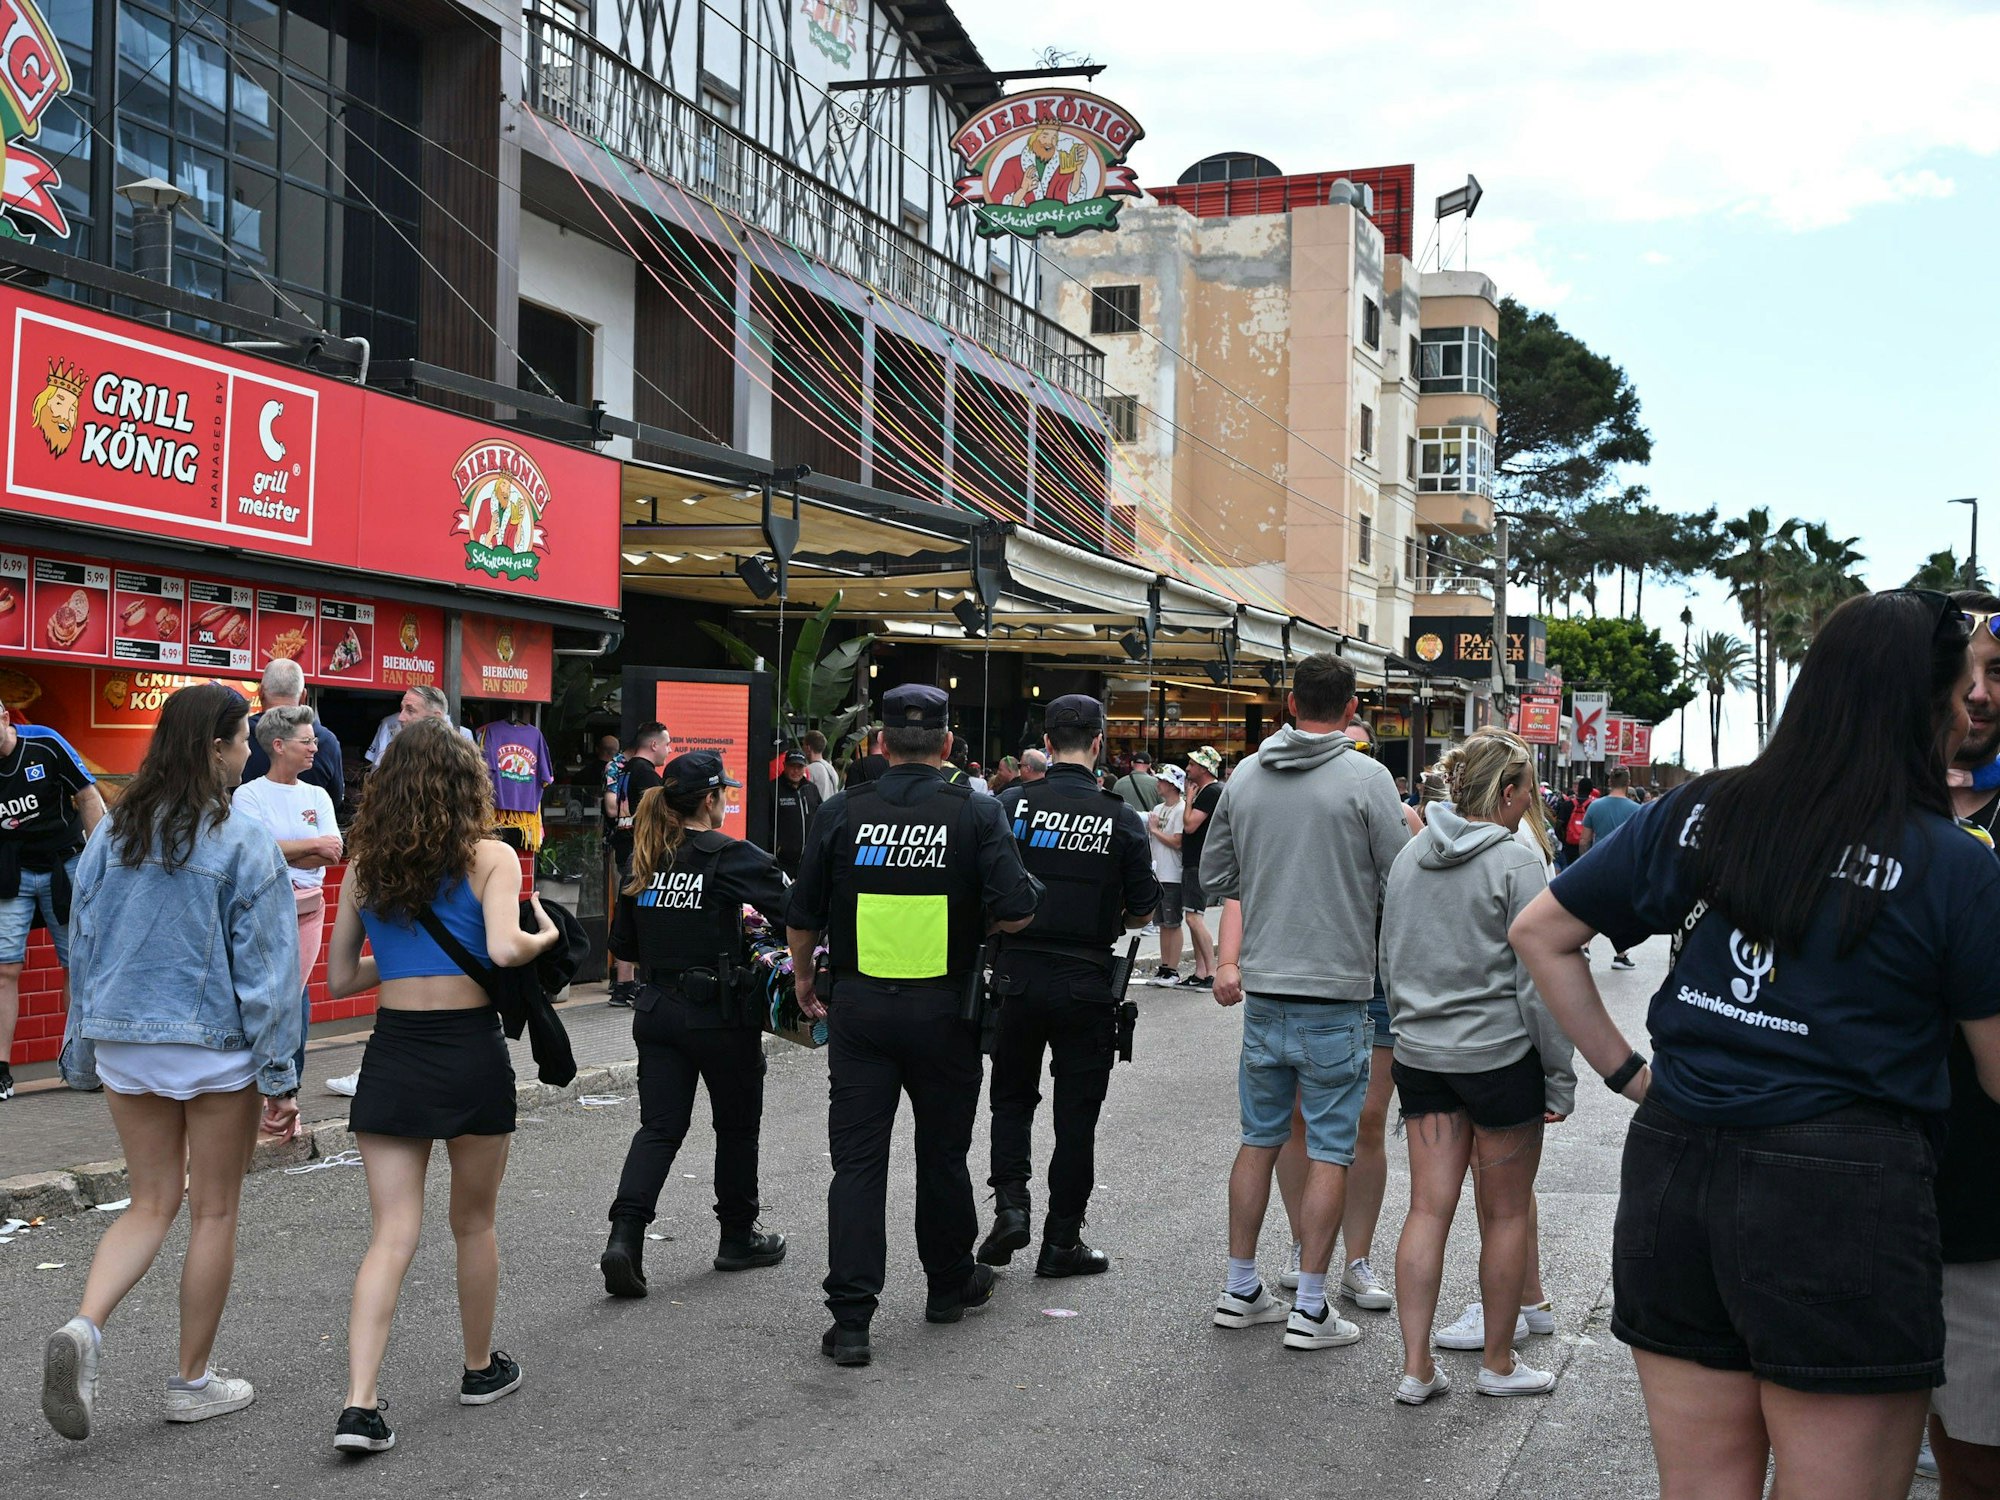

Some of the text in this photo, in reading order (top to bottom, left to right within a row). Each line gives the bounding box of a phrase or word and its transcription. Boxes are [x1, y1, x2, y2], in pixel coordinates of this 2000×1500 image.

[958, 96, 1131, 157] BIERKÖNIG
[990, 205, 1104, 228] Schinkenstrasse
[92, 372, 194, 434] GRILL
[80, 420, 200, 485] KÖNIG
[211, 382, 223, 508] MANAGED BY
[253, 470, 289, 495] grill
[456, 448, 548, 508] BIERKÖNIG
[238, 496, 300, 523] meister
[3, 559, 22, 571] 6,99
[472, 549, 533, 570] Schinkenstrasse
[87, 571, 105, 583] 5,99
[163, 582, 179, 593] 4,99
[233, 591, 249, 602] 5,99
[199, 630, 216, 643] XXL
[162, 648, 178, 659] 4,99
[232, 654, 247, 664] 5,99
[1459, 648, 1524, 660] KELER
[382, 655, 435, 673] BIERKÖNIG
[482, 665, 528, 680] BIERKÖNIG
[382, 669, 435, 687] FAN SHOP
[482, 678, 528, 694] FAN SHOP
[724, 805, 740, 814] 025
[1031, 810, 1113, 836] POLICIA
[855, 823, 947, 846] POLICIA
[1058, 832, 1111, 855] LOCAL
[885, 846, 947, 868] LOCAL
[656, 890, 703, 909] LOCAL
[1677, 985, 1809, 1036] Schinkenstrasse
